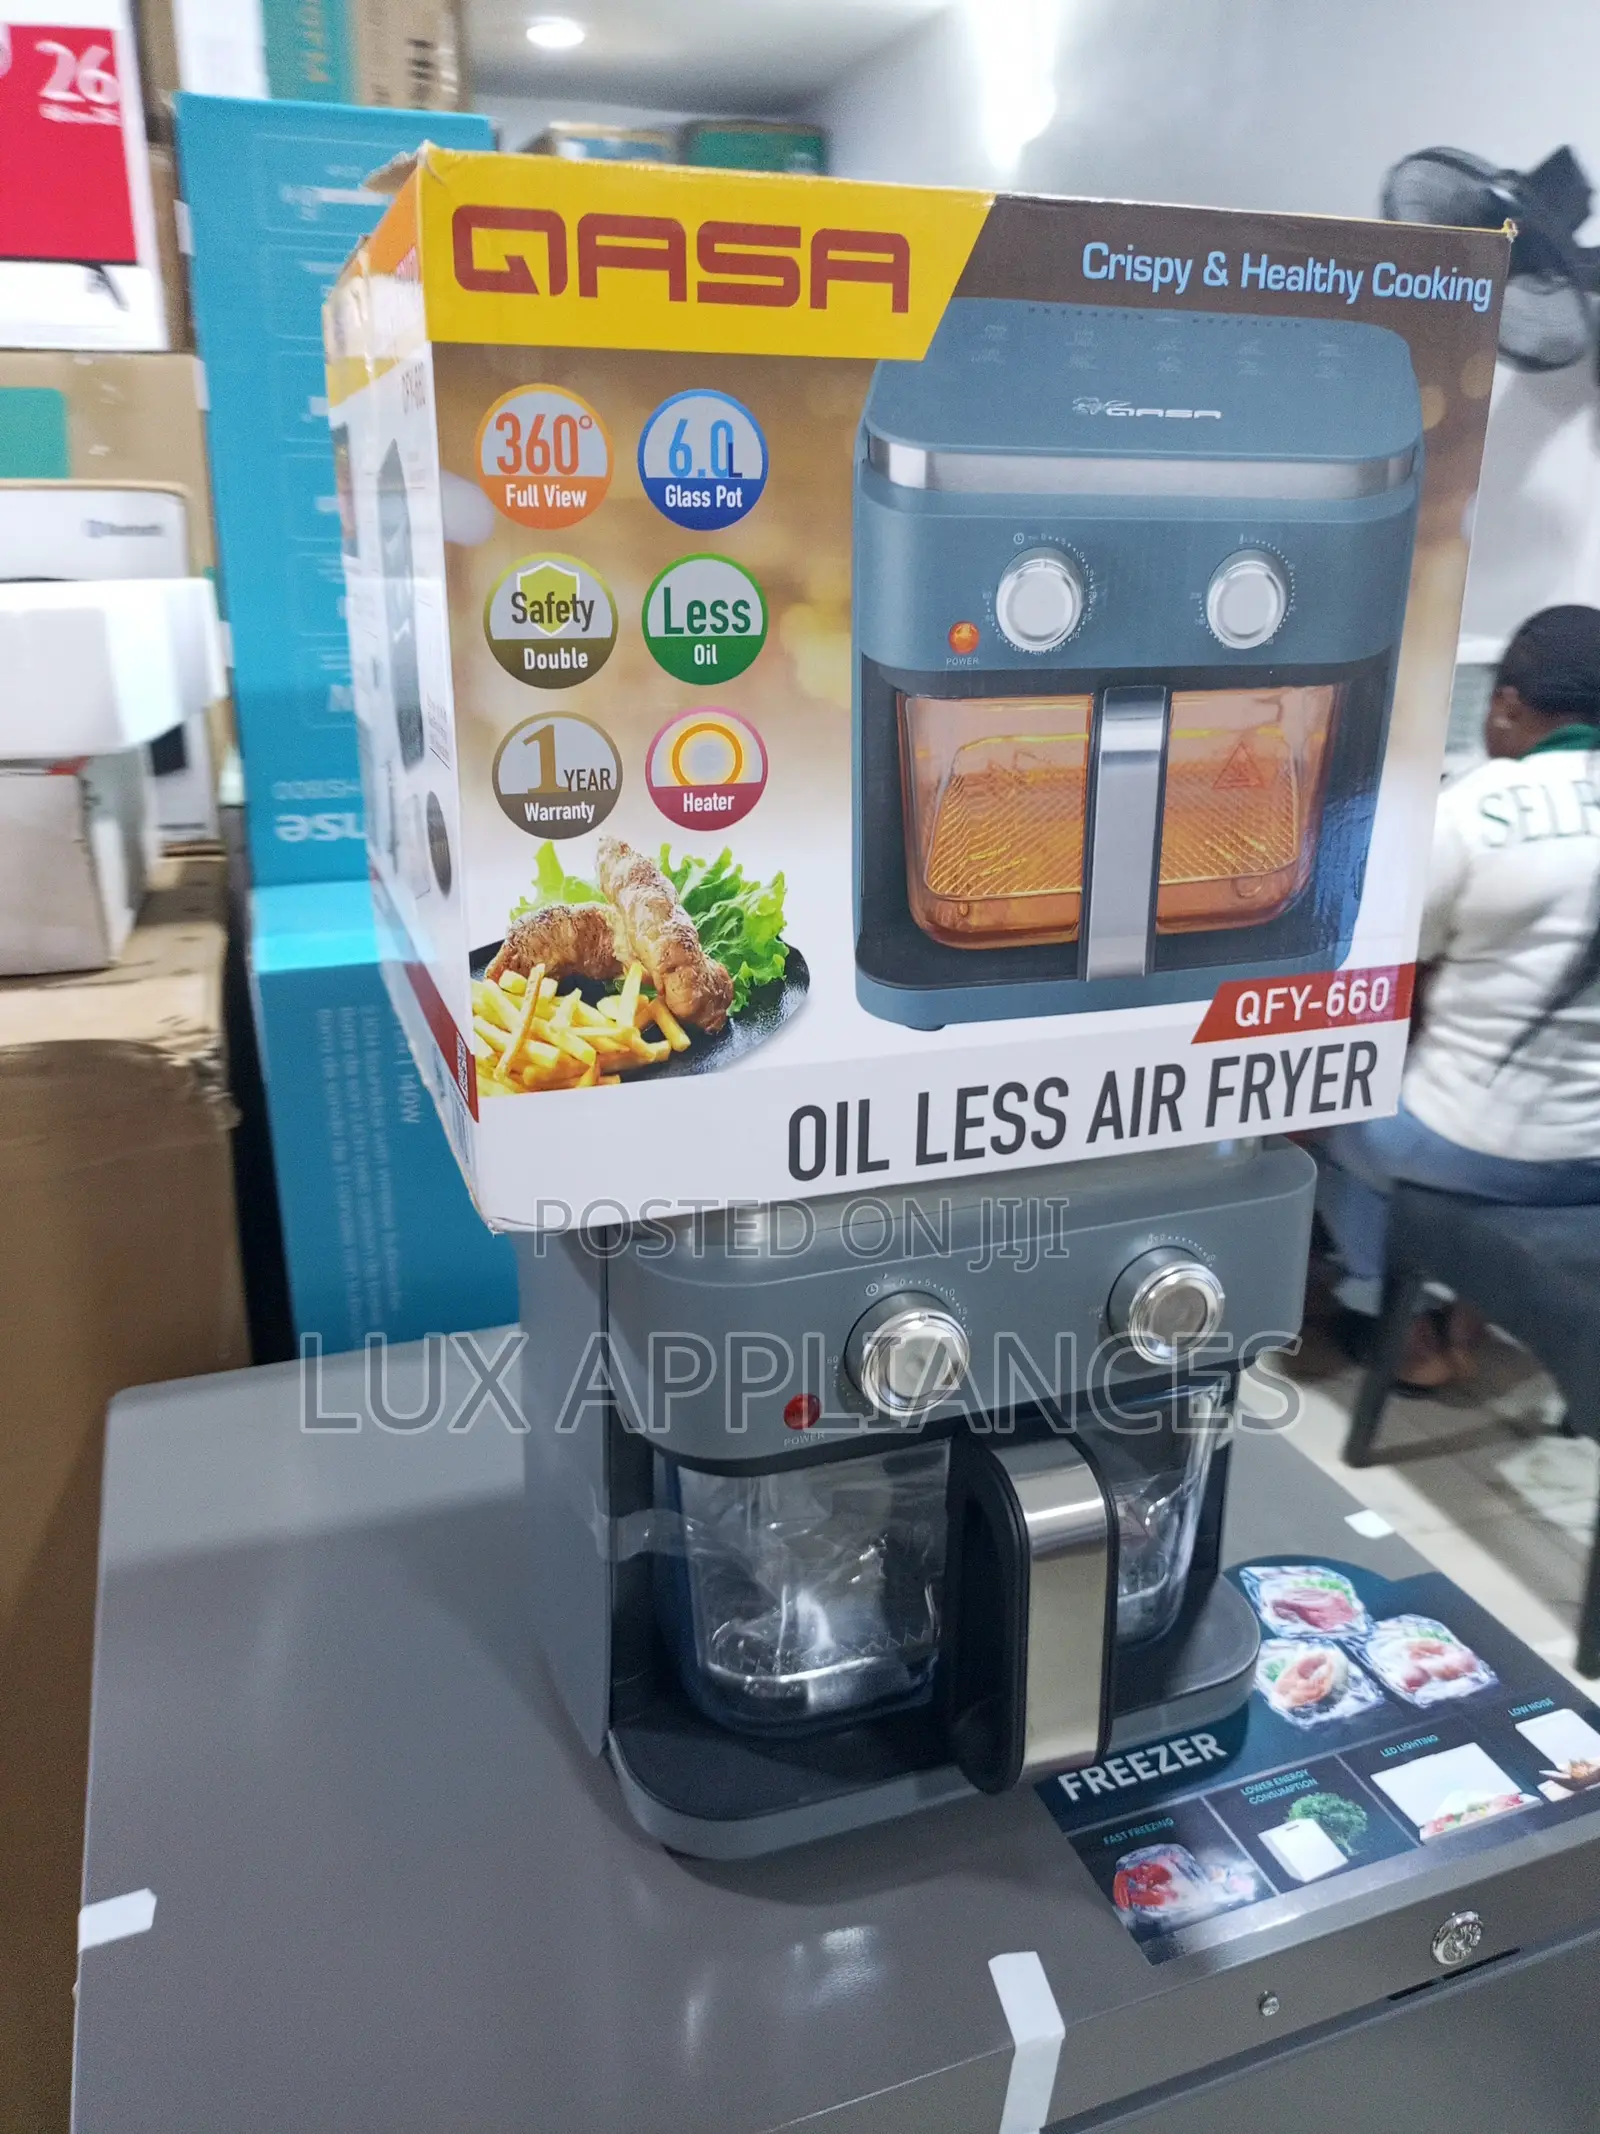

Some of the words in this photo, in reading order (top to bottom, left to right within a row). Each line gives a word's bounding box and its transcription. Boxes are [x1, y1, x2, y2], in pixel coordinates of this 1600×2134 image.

[451, 203, 911, 314] QASA
[1082, 241, 1192, 295] Crispy
[1203, 252, 1229, 287] &
[1240, 252, 1364, 304] Healthy
[1372, 262, 1493, 313] Cooking
[505, 484, 539, 508] Full
[544, 486, 587, 508] View
[665, 484, 711, 508] Glass
[715, 486, 743, 508] Pot
[510, 591, 595, 633] Safety
[663, 586, 752, 635] Less
[523, 647, 589, 670] Double
[693, 643, 718, 666] Oil
[946, 656, 979, 667] POWER
[522, 723, 570, 794] 1
[563, 767, 612, 793] YEAR
[524, 801, 596, 823] Warranty
[683, 791, 735, 813] Heater
[1235, 975, 1391, 1028] QFY-660
[787, 1098, 890, 1182] OIL
[914, 1076, 1070, 1166] LESS
[1085, 1062, 1187, 1144] AIR
[1204, 1040, 1379, 1129] FRYER
[783, 1431, 826, 1447] POWER
[1379, 1745, 1399, 1758] LED
[1396, 1733, 1440, 1754] LIGHTING
[1057, 1732, 1229, 1802] FREEZER
[1239, 1777, 1275, 1797] LOWER
[1272, 1767, 1310, 1789] ENERGY
[1247, 1777, 1319, 1806] CONSUMPTION
[1102, 1829, 1128, 1846] FAST
[1127, 1816, 1175, 1838] FREEZING
